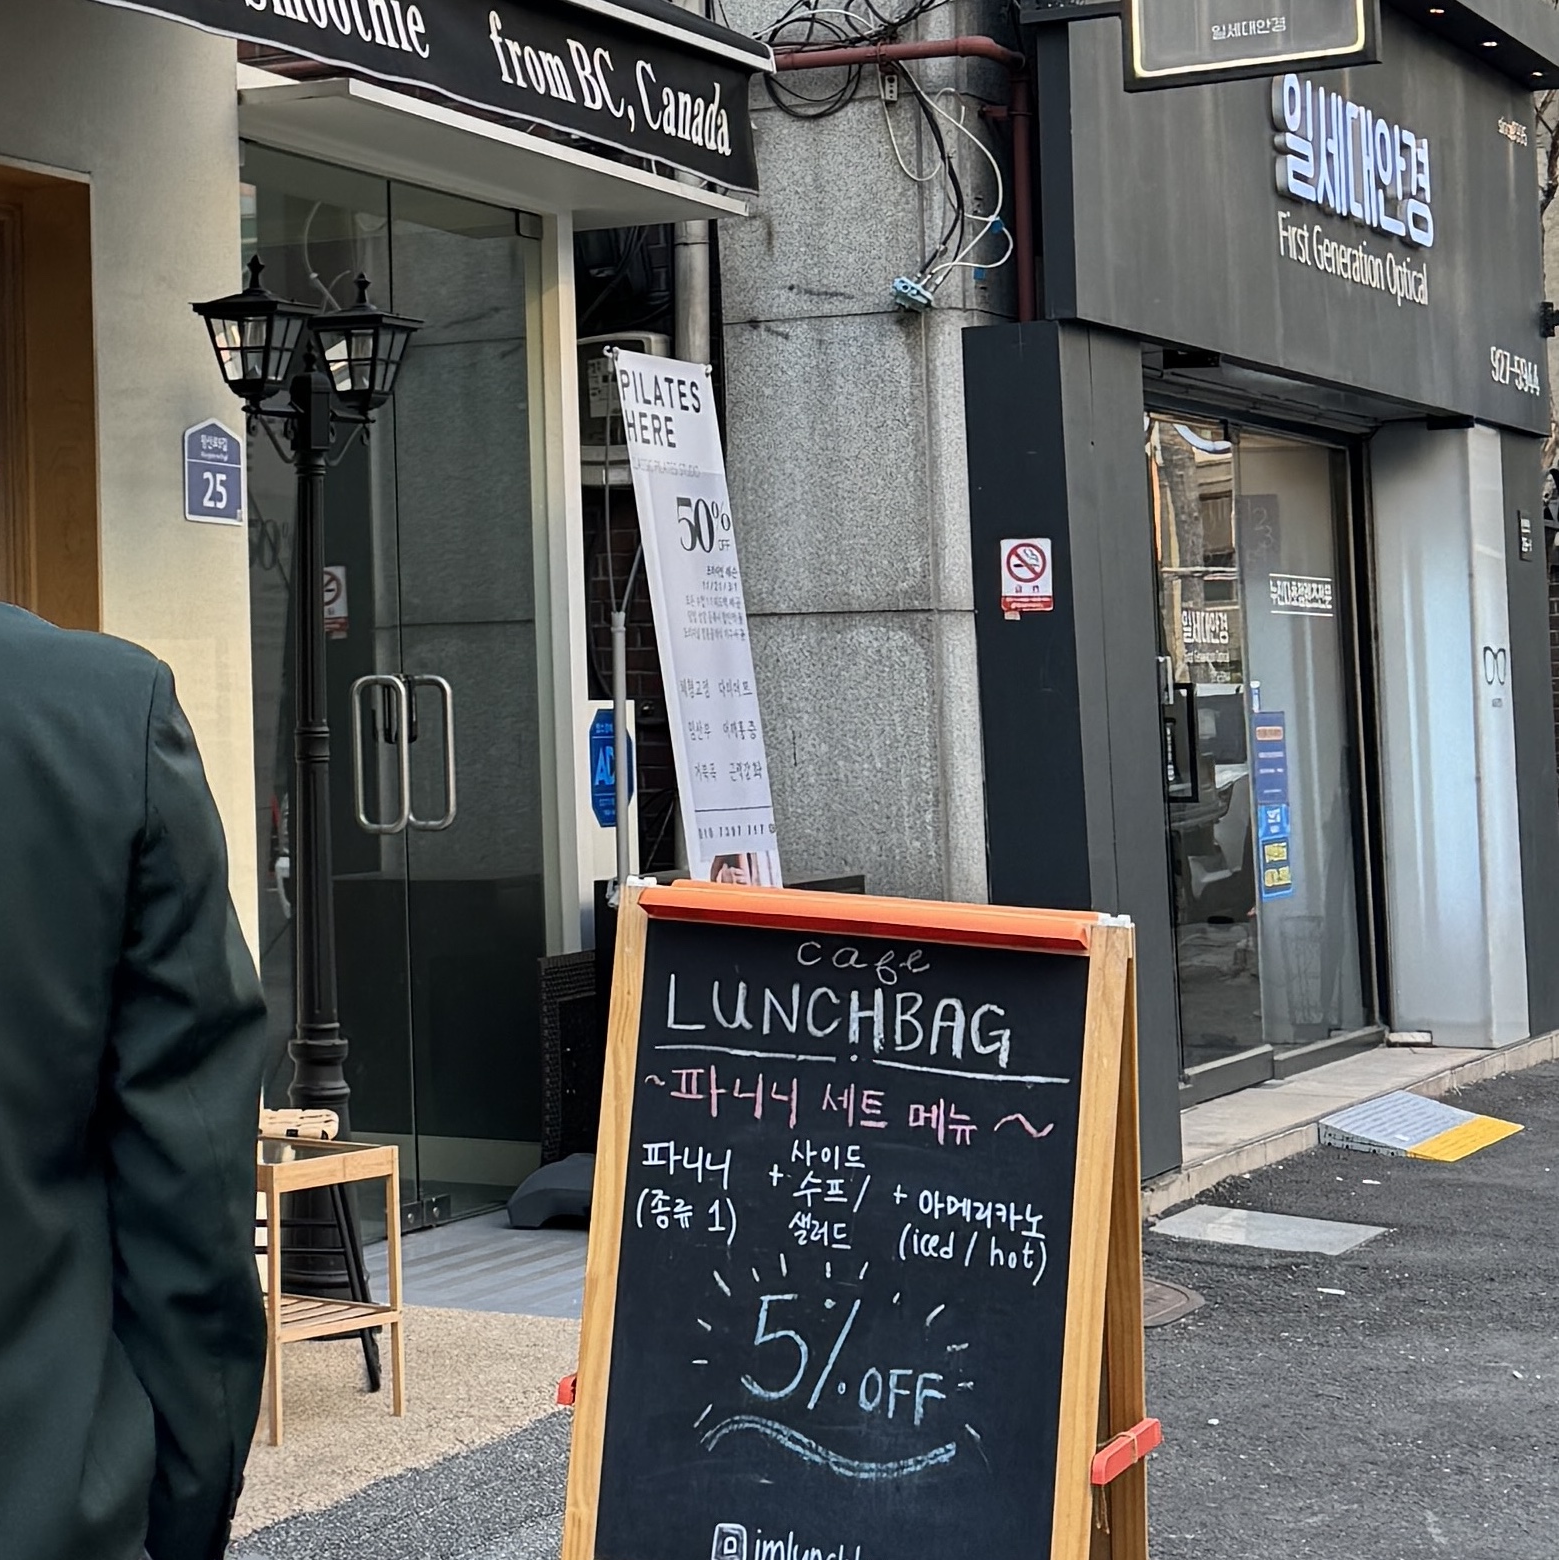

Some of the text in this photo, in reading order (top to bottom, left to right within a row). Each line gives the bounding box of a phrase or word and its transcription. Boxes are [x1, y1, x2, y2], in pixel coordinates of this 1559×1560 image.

[1211, 16, 1286, 40] 일세대안경
[246, 0, 731, 156] oothie from BC, Canada
[1274, 73, 1434, 247] 일세대안경
[1278, 210, 1429, 307] First Generation Optical
[619, 368, 701, 413] PILATES
[1490, 345, 1540, 396] 927-5944
[625, 409, 677, 448] HERE
[202, 471, 228, 509] 25
[676, 496, 731, 553] 50%
[797, 941, 930, 985] cafe
[668, 973, 1010, 1068] LUNCHBAG
[822, 1083, 888, 1128] 세트
[909, 1098, 977, 1145] 메뉴
[642, 1140, 731, 1190] 파니니
[792, 1140, 866, 1170] 사이드
[788, 1211, 852, 1250] 샐러드
[918, 1189, 1046, 1239] 아메리카노
[741, 1293, 947, 1426] 5% OFF
